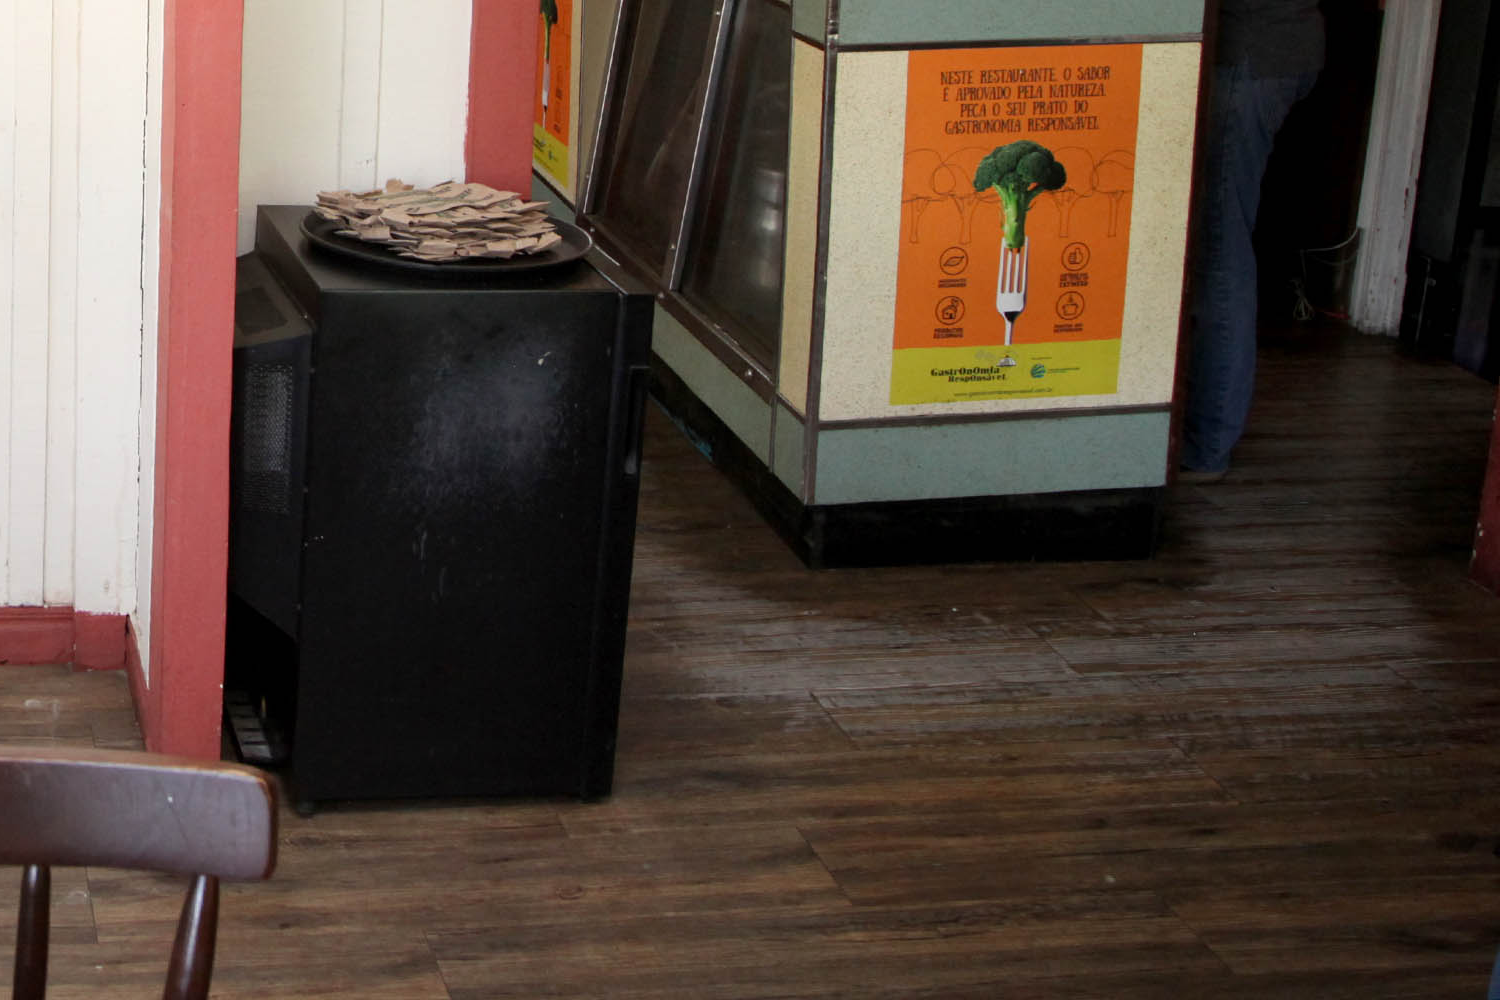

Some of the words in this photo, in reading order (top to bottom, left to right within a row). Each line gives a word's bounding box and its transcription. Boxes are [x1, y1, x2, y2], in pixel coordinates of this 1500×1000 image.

[940, 70, 973, 85] NESTE
[980, 68, 1056, 84] RESTAURANTE
[1063, 67, 1071, 81] O
[1077, 65, 1111, 81] SABOR
[956, 86, 1012, 101] APROVADO
[1017, 85, 1043, 99] PELA
[1049, 83, 1107, 98] NATUREZA
[992, 103, 1001, 116] O
[1006, 102, 1026, 116] SEU
[1033, 101, 1068, 115] PRATO
[1074, 100, 1089, 114] DO
[945, 118, 1021, 135] GASTRONOMIA
